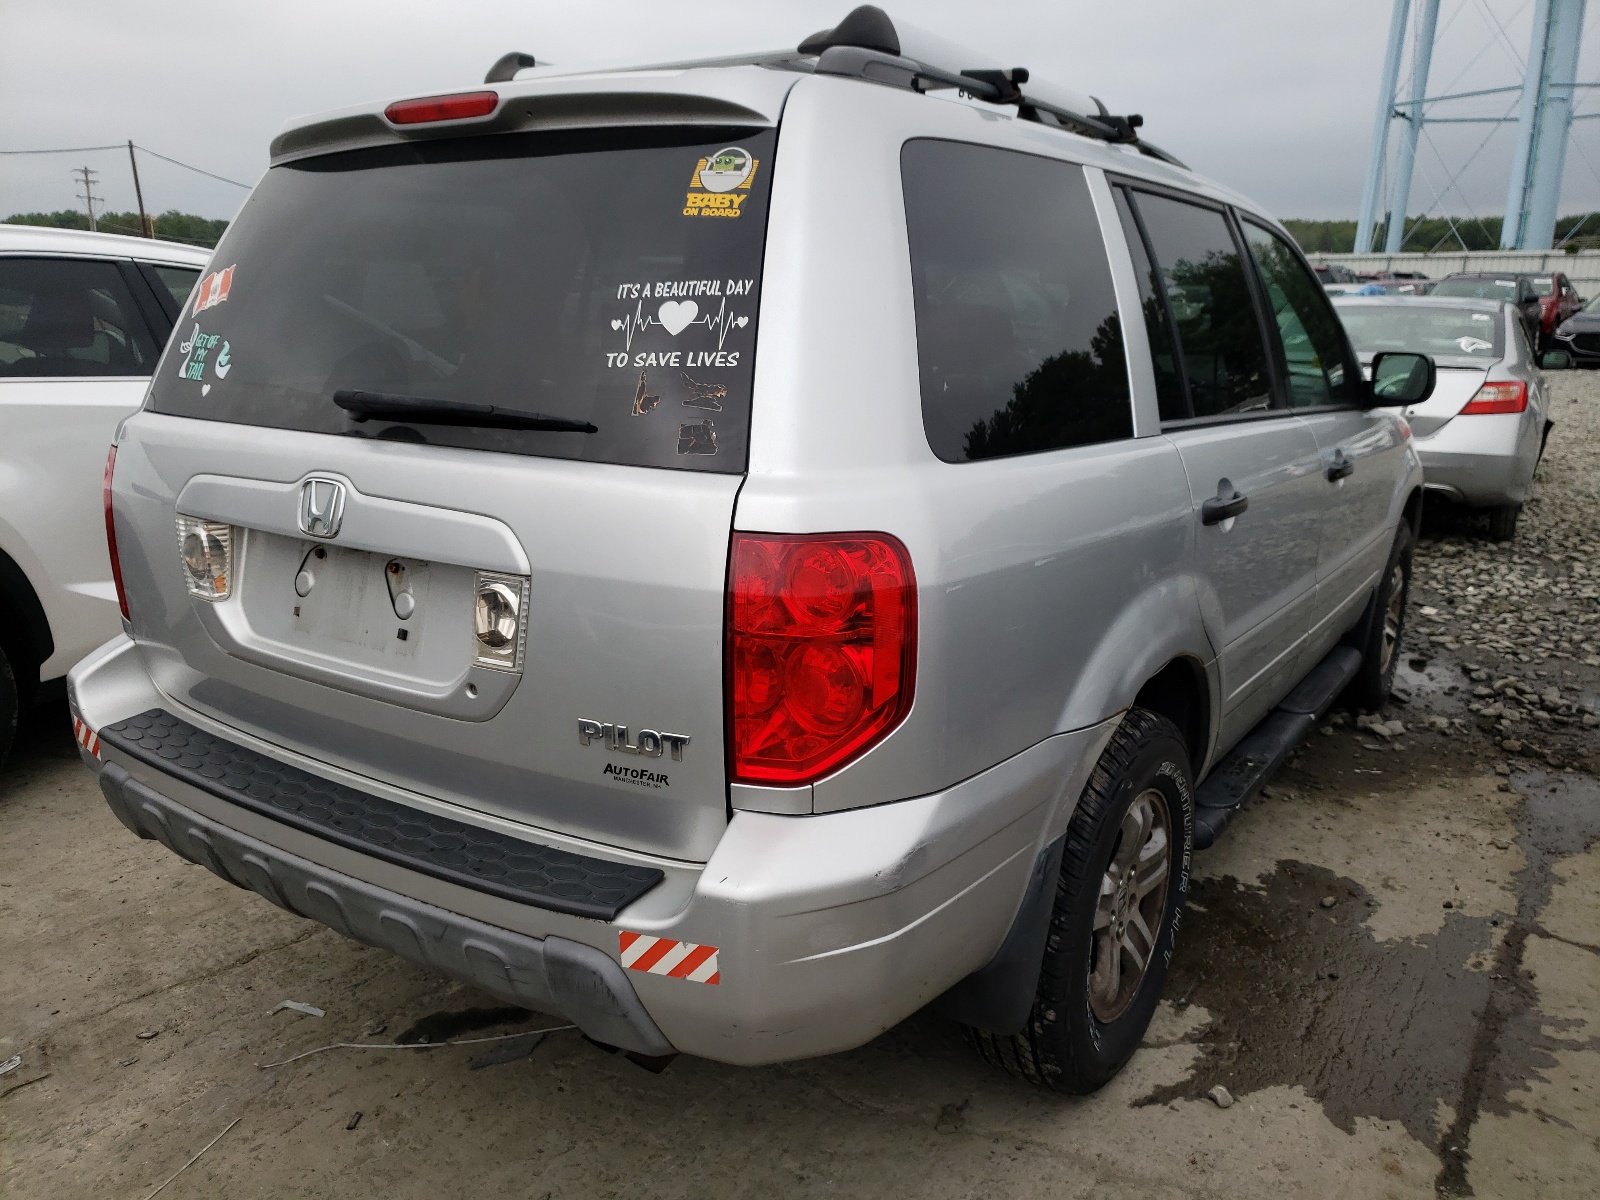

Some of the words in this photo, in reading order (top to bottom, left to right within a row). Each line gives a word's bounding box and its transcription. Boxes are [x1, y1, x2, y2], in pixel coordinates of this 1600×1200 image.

[686, 193, 747, 208] BABY
[682, 207, 699, 216] ON
[701, 208, 741, 217] BOARD
[617, 283, 640, 299] IT'S
[642, 282, 651, 298] A
[654, 279, 722, 298] BEAUTIFUL
[726, 279, 754, 296] DAY
[195, 332, 209, 348] GET
[207, 334, 221, 349] OFF
[194, 348, 208, 361] MY
[606, 352, 629, 368] TO
[633, 352, 682, 367] SAVE
[686, 351, 741, 367] LIVES
[186, 362, 205, 381] TAIL
[578, 717, 691, 761] PILOT
